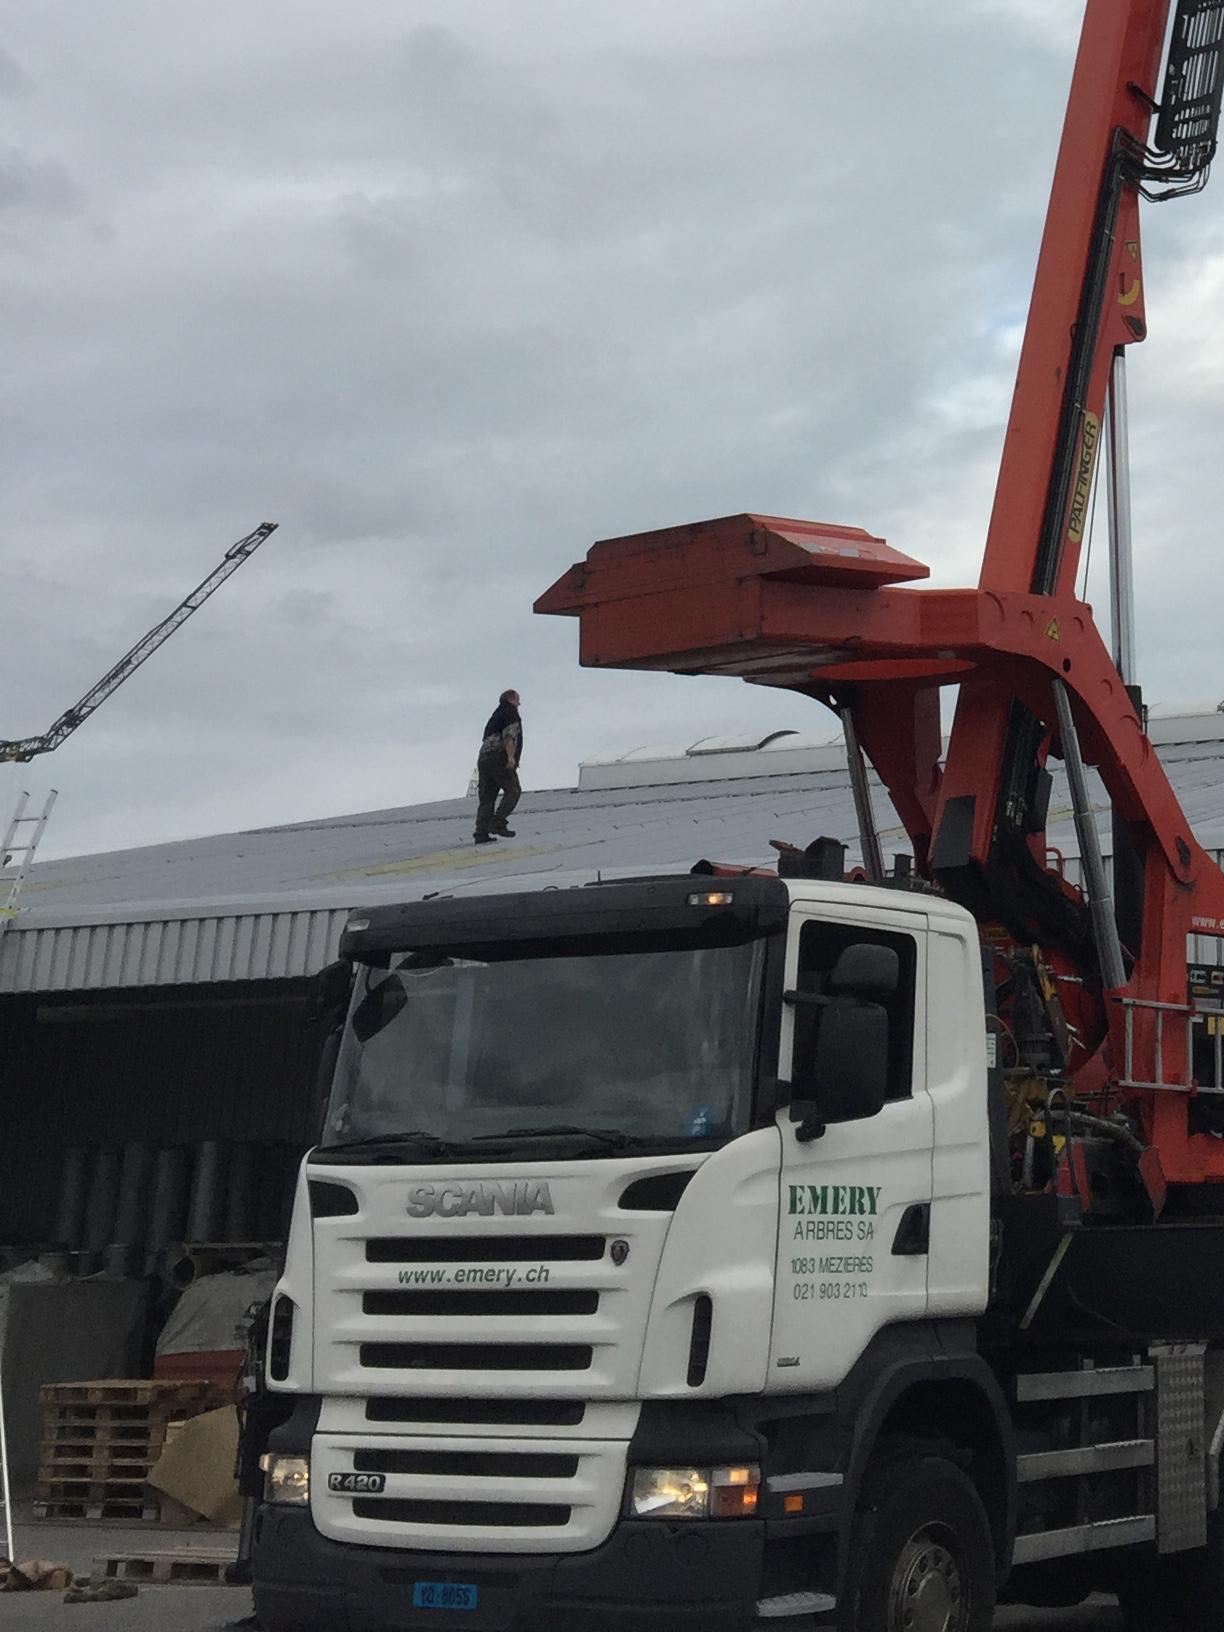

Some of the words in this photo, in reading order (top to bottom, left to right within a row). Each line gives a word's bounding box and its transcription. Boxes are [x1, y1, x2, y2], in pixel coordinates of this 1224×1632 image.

[1069, 420, 1097, 535] PALFINGER
[406, 1183, 555, 1218] SCANIA
[788, 1185, 882, 1215] EMERY
[794, 1220, 853, 1240] ARBRES
[857, 1220, 874, 1240] SA
[398, 1265, 550, 1287] www.emery.ch
[791, 1257, 815, 1274] 1083
[794, 1283, 815, 1300] 021
[819, 1282, 840, 1299] 903
[330, 1474, 341, 1489] R
[343, 1475, 381, 1491] 420
